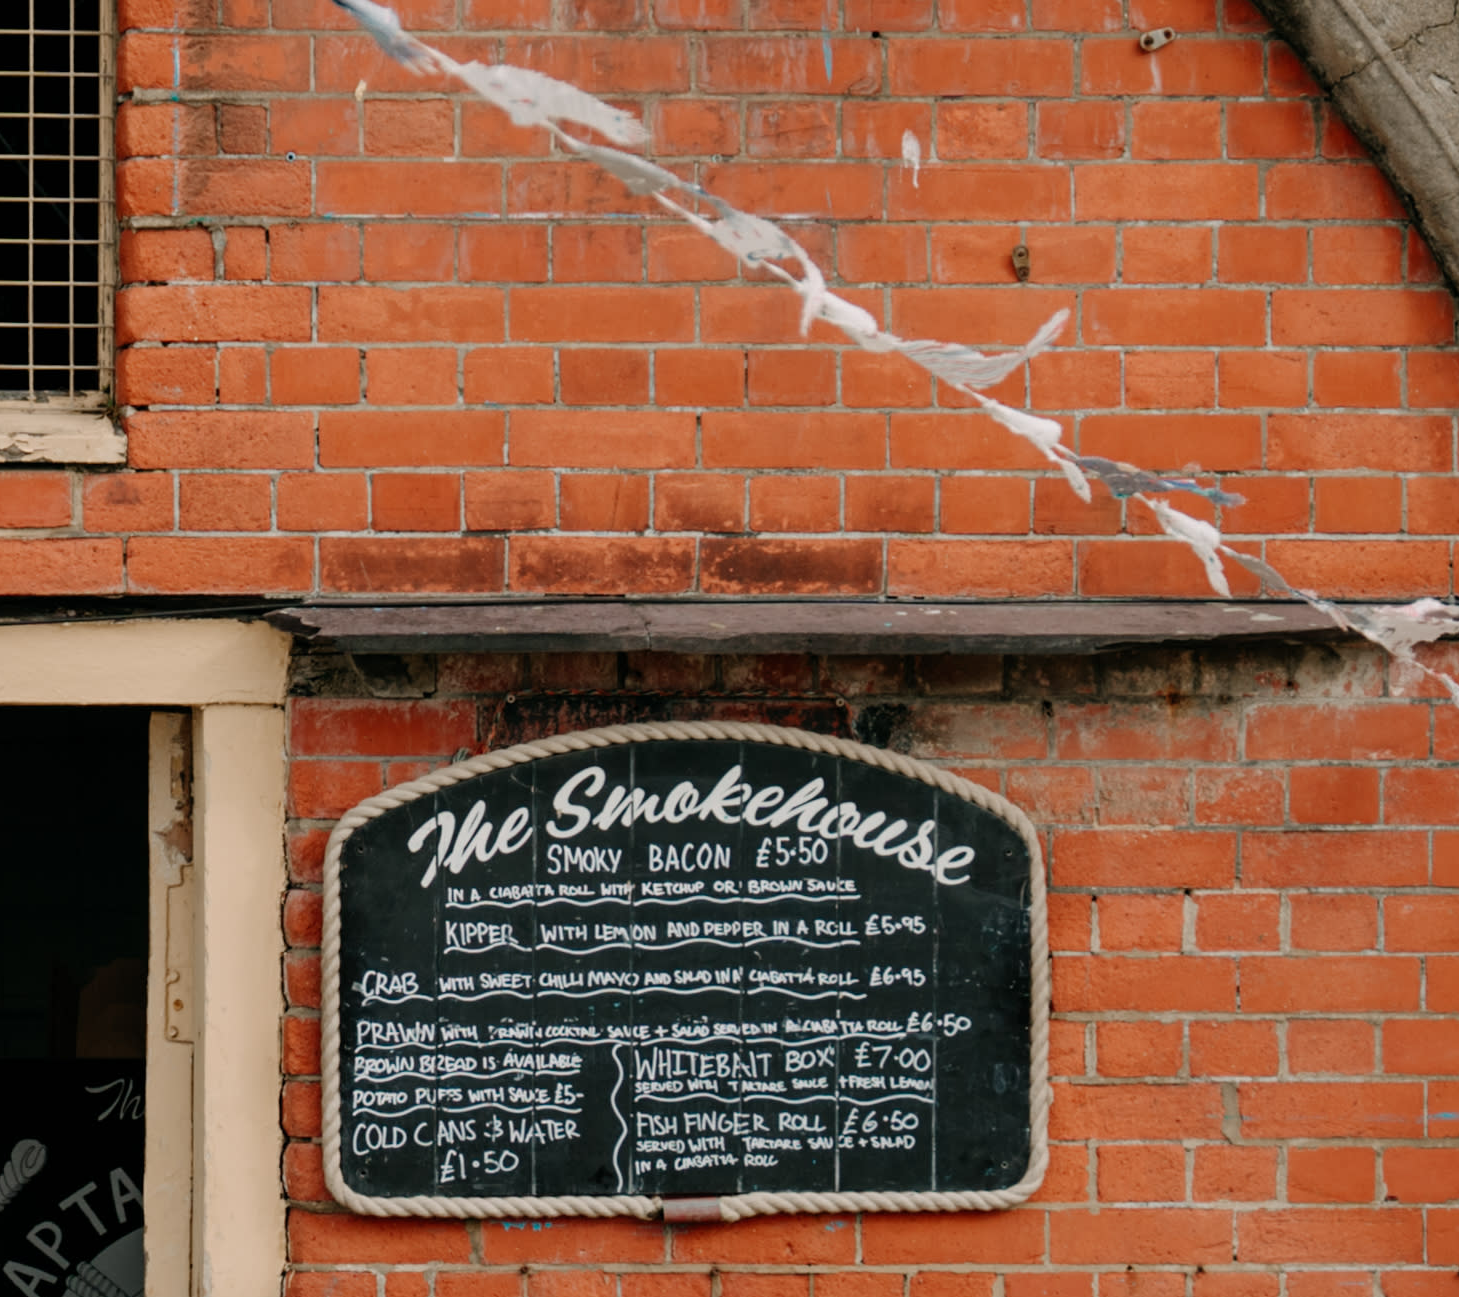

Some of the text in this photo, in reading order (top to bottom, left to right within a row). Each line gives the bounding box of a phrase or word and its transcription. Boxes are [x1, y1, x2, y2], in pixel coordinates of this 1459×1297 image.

[408, 765, 975, 888] The Smokehouse
[547, 837, 828, 875] SMOKY BACON £5.50
[448, 879, 856, 903] IN CIABATTA ROLL KETCHUP BROWN SAUCE
[445, 915, 926, 946] KIPPER WITH LEMON AND PEPPER IN ROLL £5.95
[362, 967, 926, 996] CRAB WITH SWEET CHILLI MAYO AND CIABATTA ROLL £6.95
[357, 1012, 971, 1044] PRAWN WITH £6.50
[354, 1052, 583, 1076] BROWN BREAD AVAILABLE
[635, 1046, 772, 1080] WHITEBAIT
[855, 1042, 931, 1072] £7.00
[353, 1088, 550, 1105] POTATO WITH SAUCE
[353, 1119, 580, 1156] COLD CANS WATER
[636, 1108, 919, 1137] FISH FINGER ROLL £6.50
[687, 1137, 803, 1153] WITH TARTARE
[441, 1150, 519, 1183] £1.50
